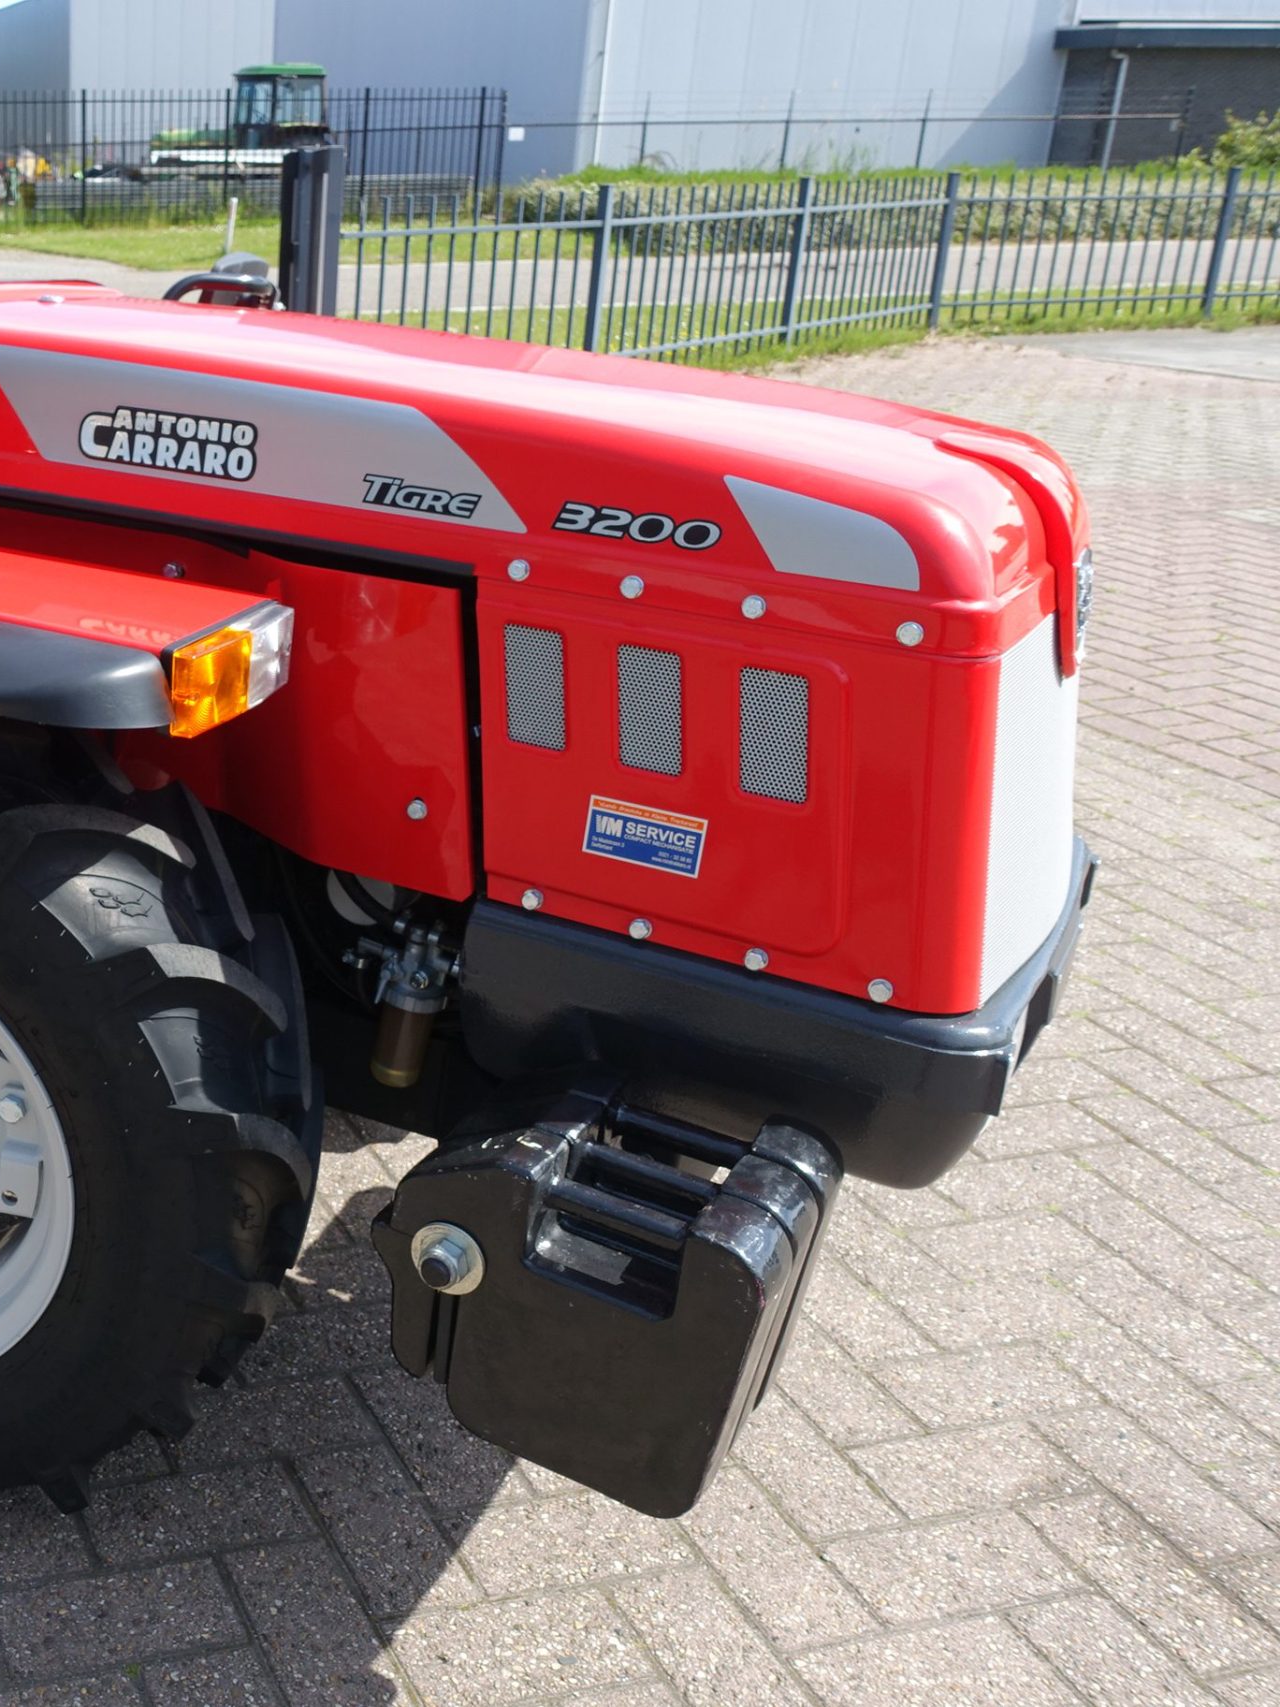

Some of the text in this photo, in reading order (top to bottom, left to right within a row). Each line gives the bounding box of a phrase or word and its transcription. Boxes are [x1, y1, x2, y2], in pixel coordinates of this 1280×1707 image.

[80, 413, 254, 480] CARRARO
[113, 408, 255, 447] ANTONIO
[553, 502, 722, 550] 3200
[624, 834, 652, 846] COMPACT
[625, 821, 697, 849] SERVICE
